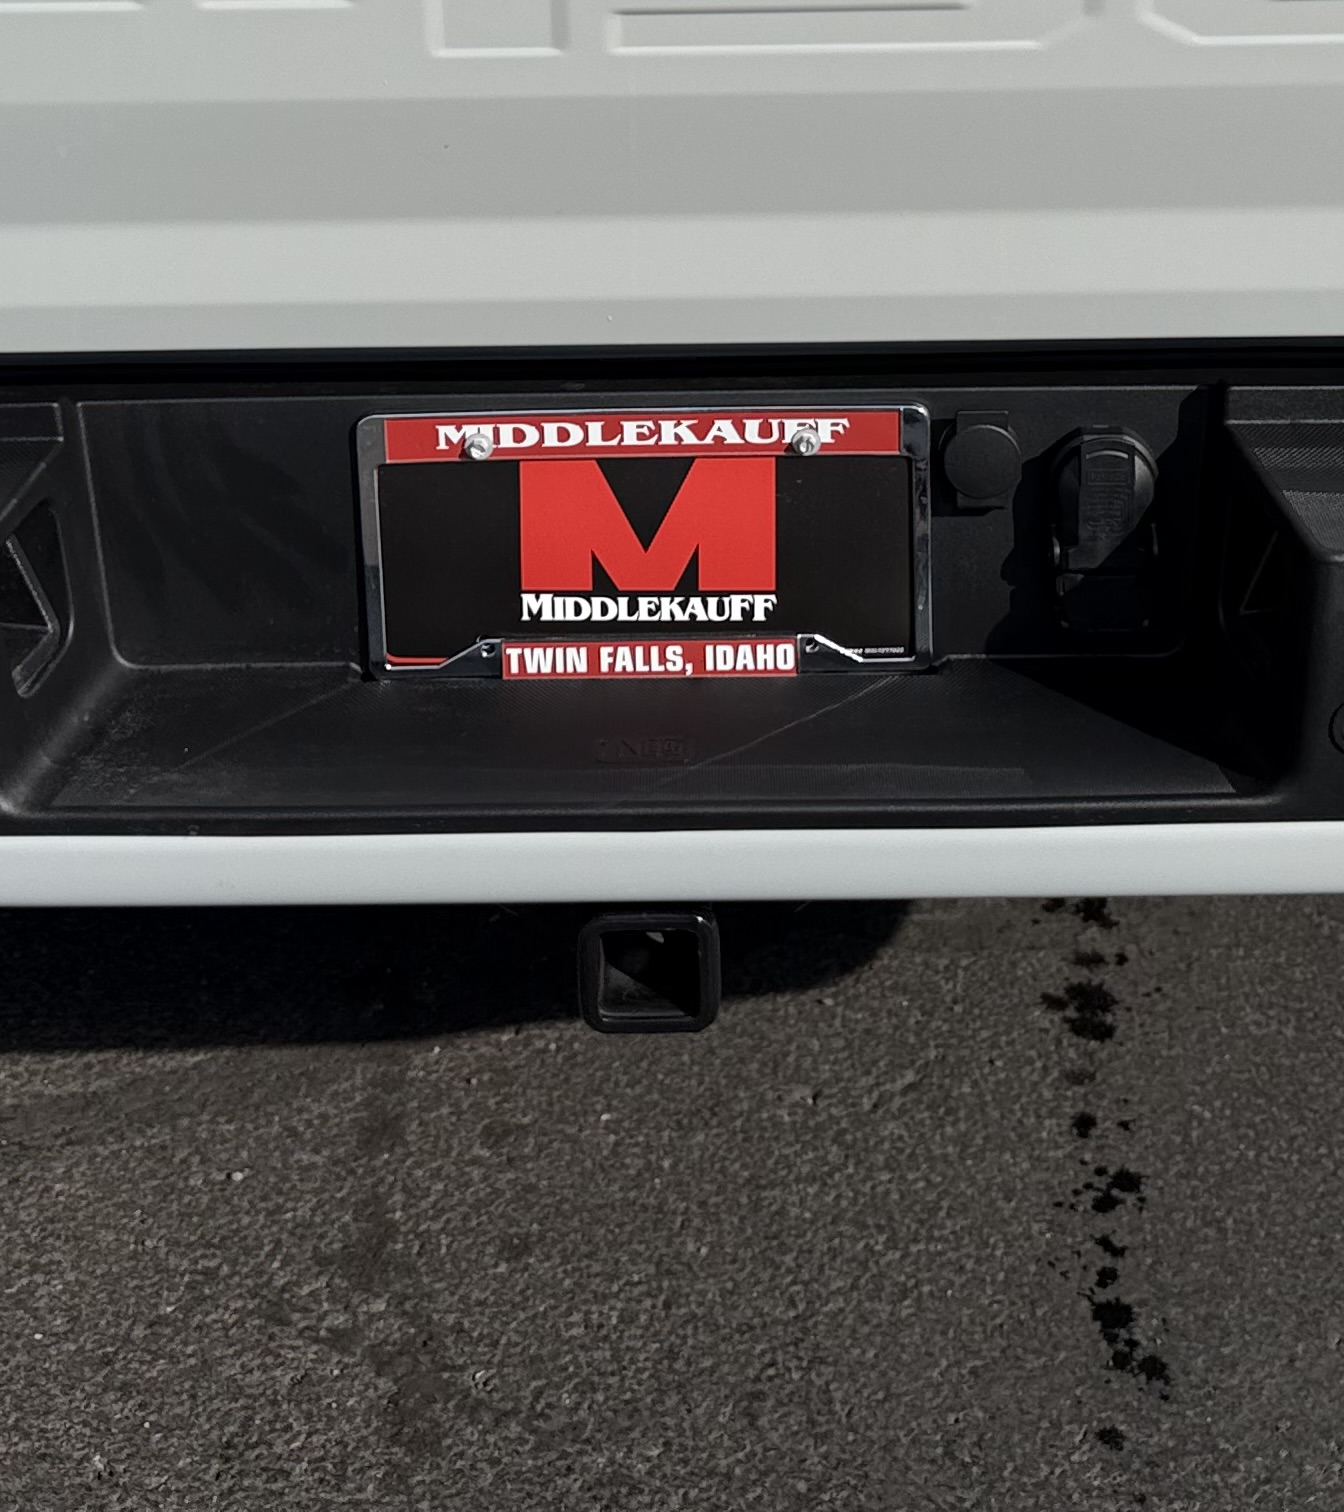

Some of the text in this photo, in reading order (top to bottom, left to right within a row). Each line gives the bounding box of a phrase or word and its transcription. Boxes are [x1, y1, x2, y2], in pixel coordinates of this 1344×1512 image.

[520, 592, 778, 622] MIDDLEKAUFF
[505, 642, 796, 677] TWIN FALLS, IDAHO
